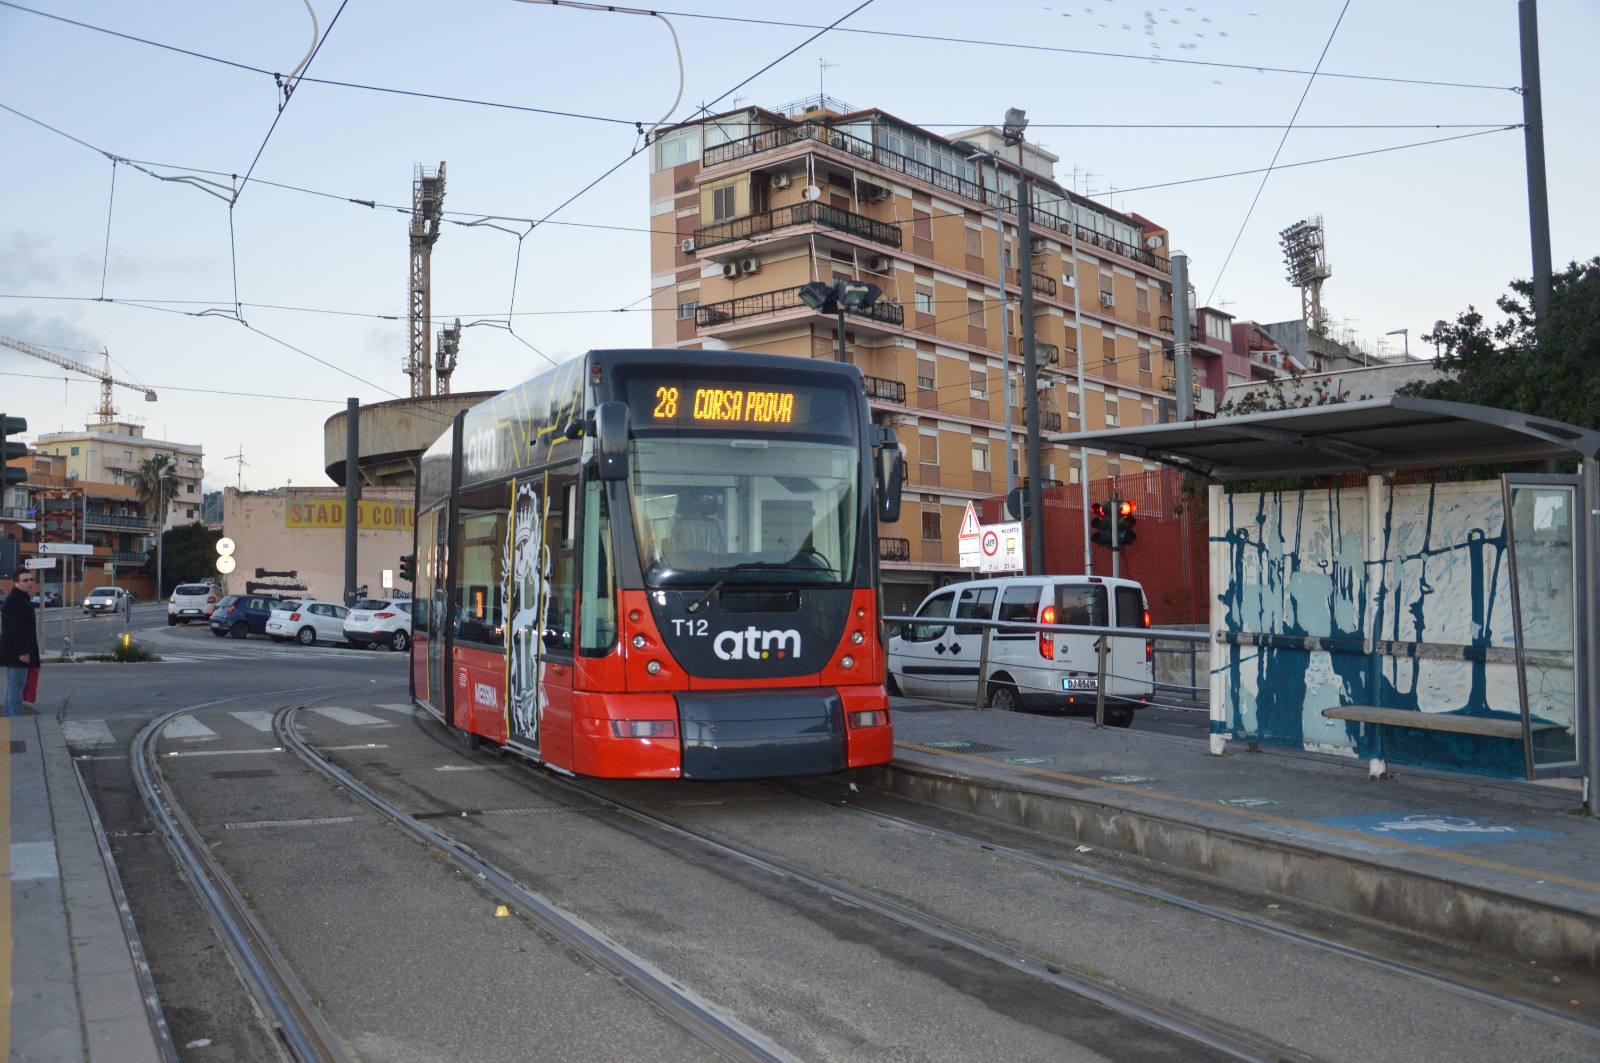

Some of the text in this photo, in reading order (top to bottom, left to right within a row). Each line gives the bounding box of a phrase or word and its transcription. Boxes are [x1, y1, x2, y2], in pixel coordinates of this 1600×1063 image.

[653, 387, 794, 423] 28 CORSA PROVA
[467, 427, 496, 473] atm
[291, 504, 364, 524] STADO
[671, 619, 709, 637] T12
[713, 626, 802, 661] atm
[474, 682, 498, 708] MESSINA
